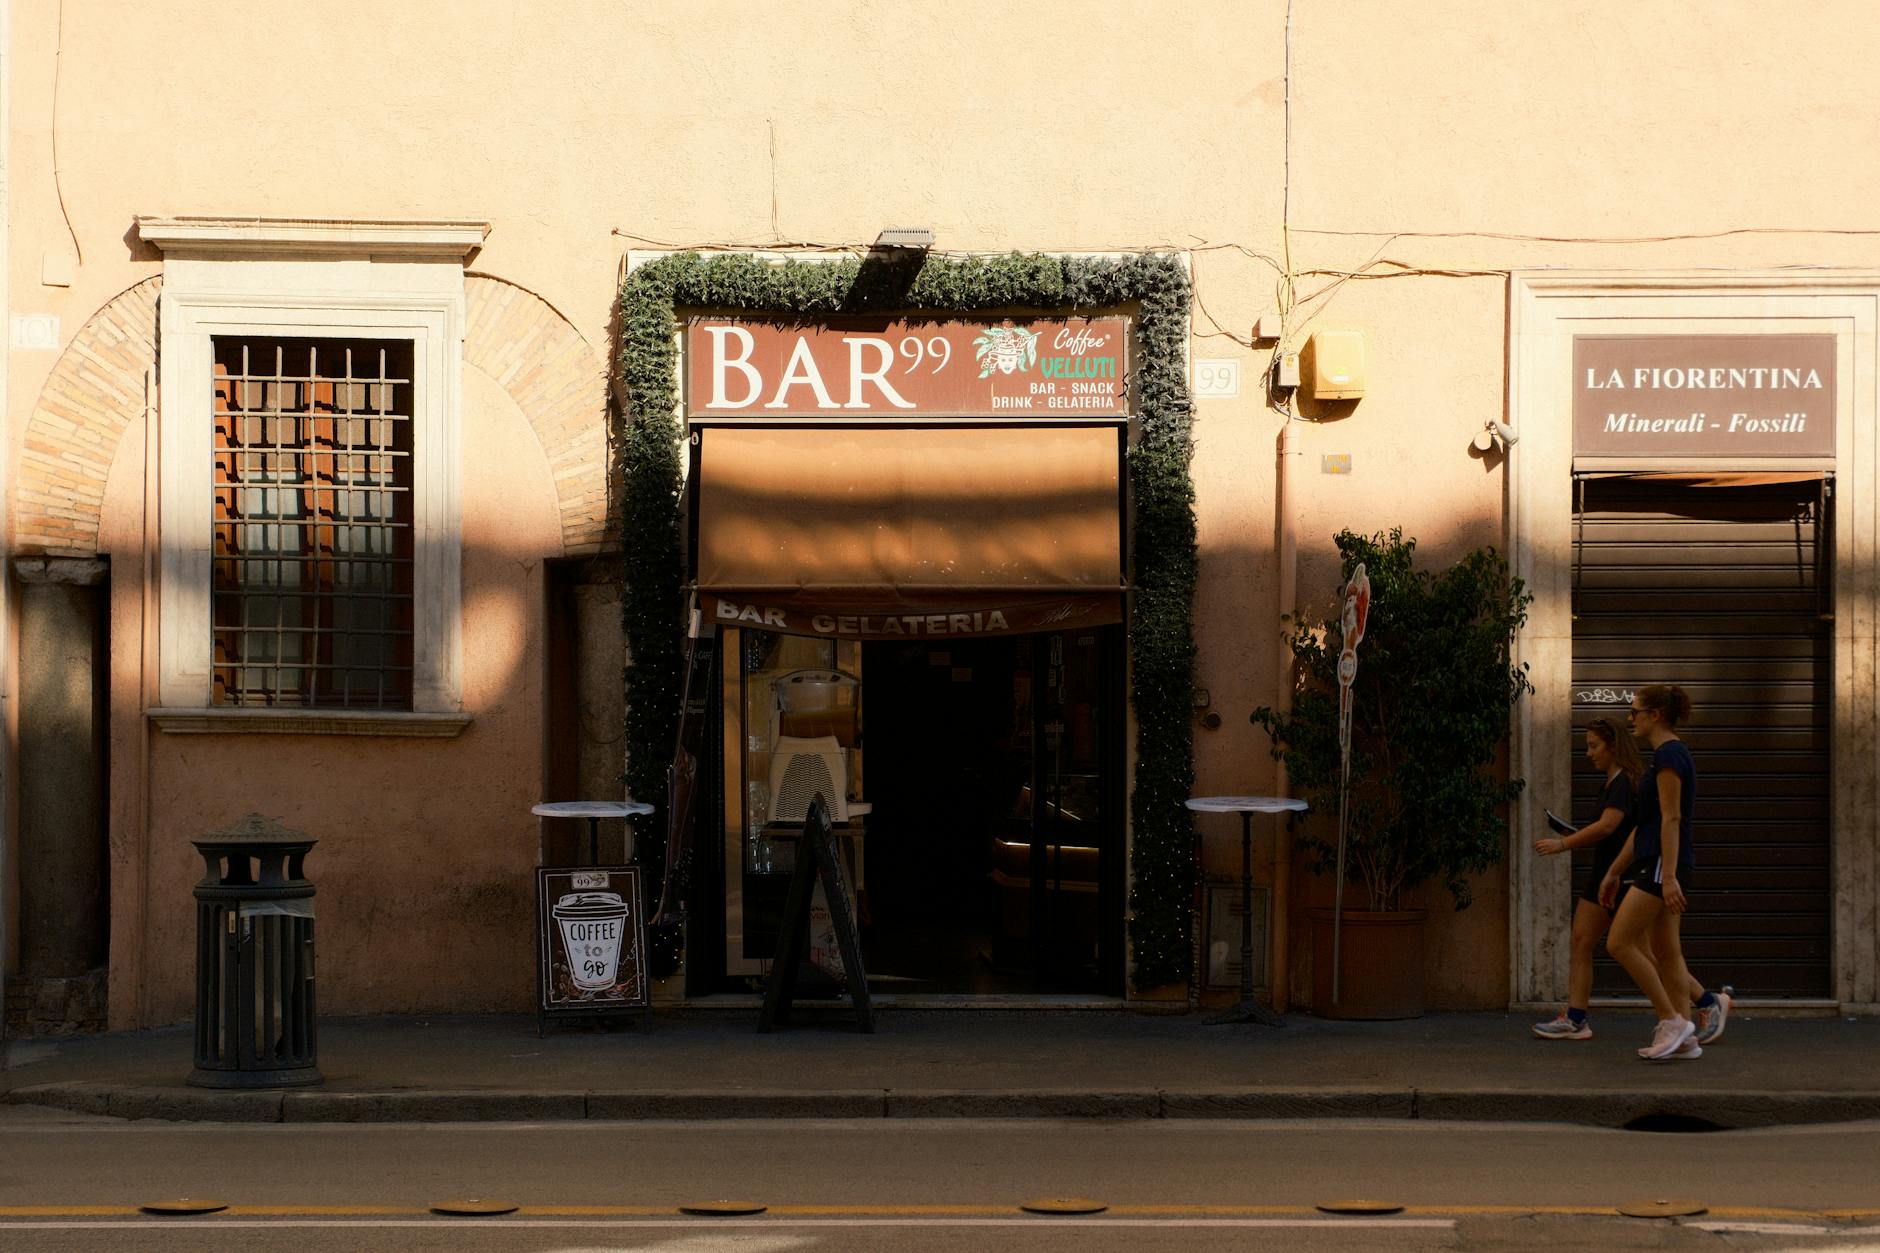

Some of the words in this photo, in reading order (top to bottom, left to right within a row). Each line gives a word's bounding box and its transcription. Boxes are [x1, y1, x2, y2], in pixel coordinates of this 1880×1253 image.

[1053, 328, 1105, 356] Coffee
[704, 325, 917, 409] BAR
[899, 336, 951, 374] 99
[1040, 357, 1116, 378] VELLUTI
[1029, 382, 1056, 395] BAR
[1071, 382, 1115, 395] SNACK
[1199, 368, 1231, 390] 99
[1586, 367, 1625, 389] LA
[1633, 367, 1823, 389] FIORENTINA
[992, 396, 1032, 408] DRINK
[1047, 396, 1115, 409] GELATERIA
[1603, 412, 1705, 433] Minerali
[1727, 412, 1807, 433] Fossili
[716, 599, 787, 628] BAR
[811, 610, 1009, 635] GELATERIA
[577, 879, 590, 888] 99
[570, 923, 616, 941] COFFEE
[584, 944, 604, 957] to
